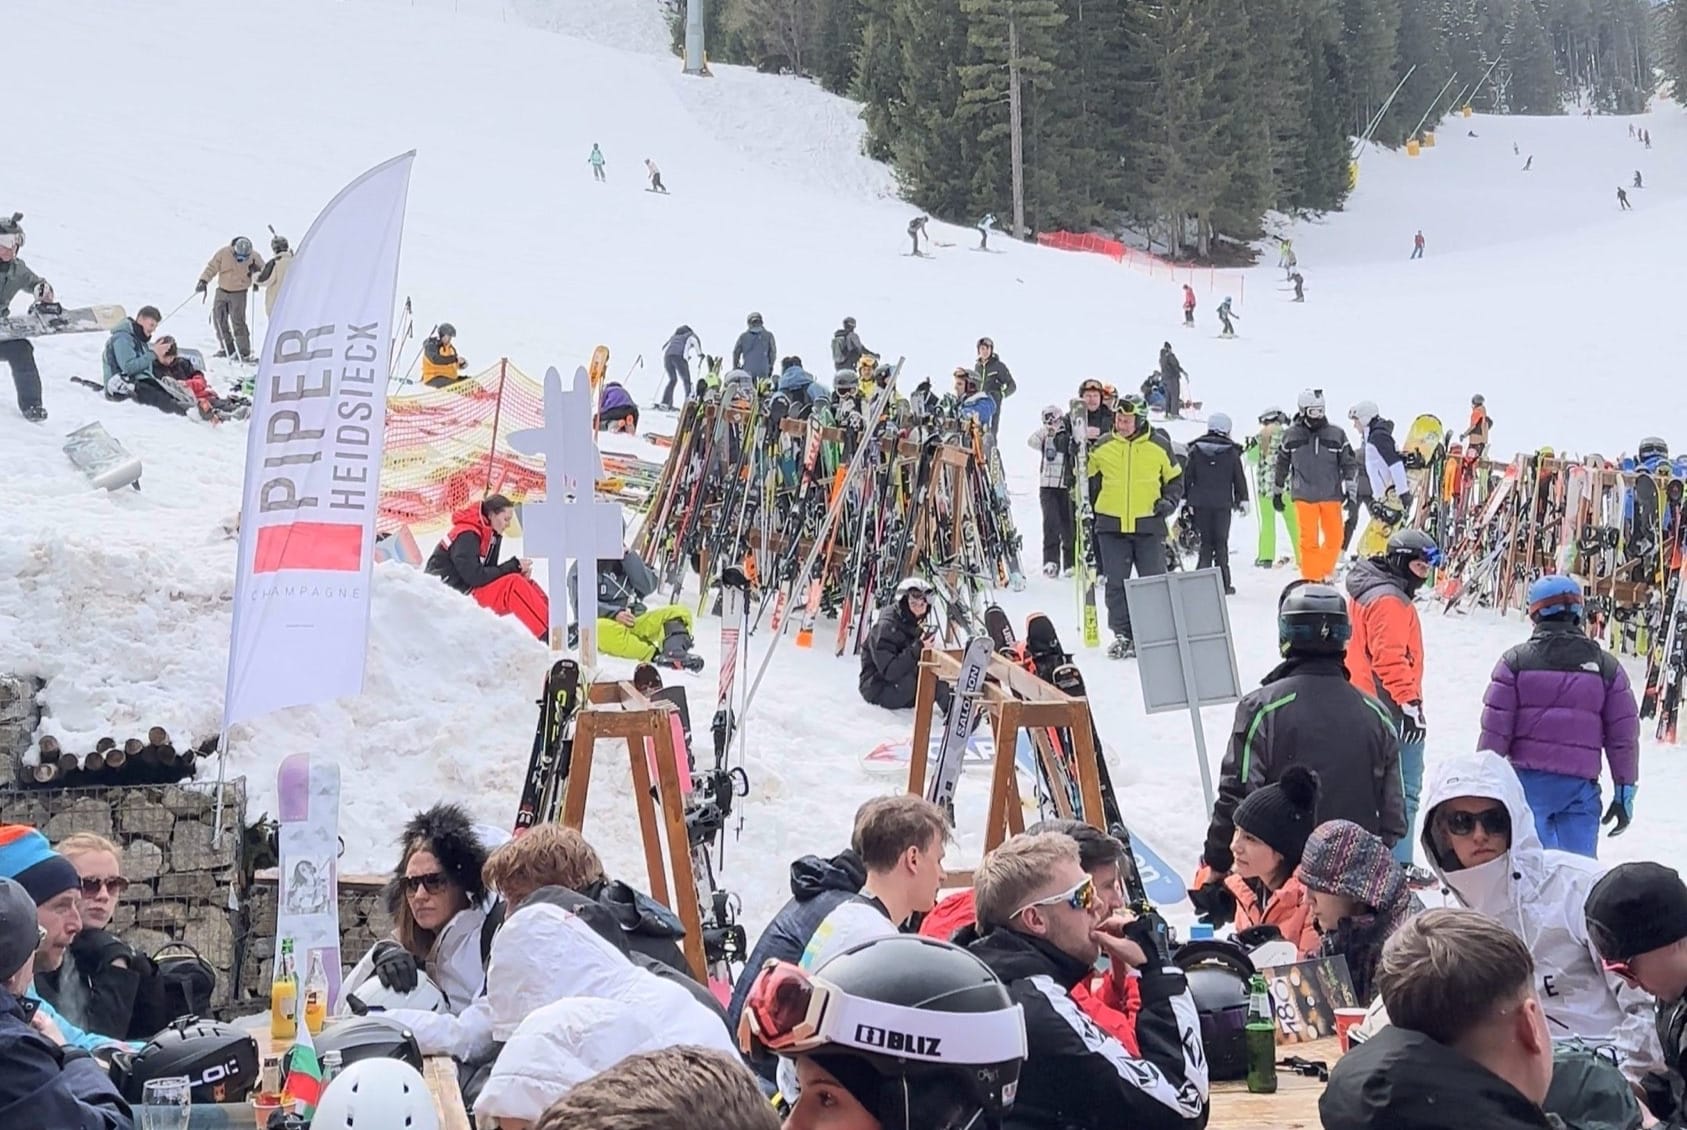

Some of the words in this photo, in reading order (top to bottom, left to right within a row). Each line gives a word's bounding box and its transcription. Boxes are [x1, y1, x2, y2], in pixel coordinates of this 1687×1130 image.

[259, 324, 335, 512] PIPER
[330, 321, 379, 510] HEIDSIECK
[251, 585, 361, 601] CHAMPAGNE
[887, 1030, 941, 1057] BLIZ
